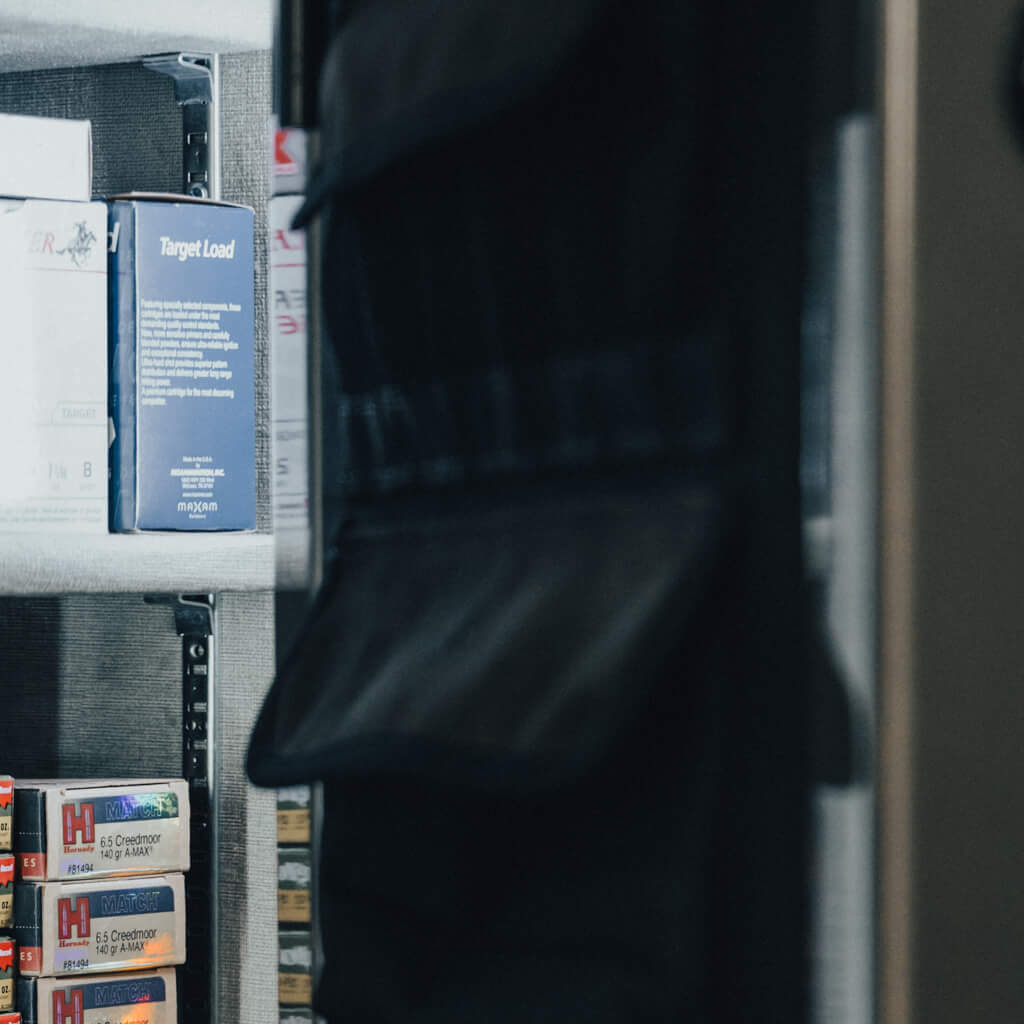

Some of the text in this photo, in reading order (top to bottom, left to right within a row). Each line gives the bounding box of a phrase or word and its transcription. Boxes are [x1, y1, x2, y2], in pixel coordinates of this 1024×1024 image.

[159, 236, 236, 262] Target Load
[104, 799, 163, 820] MATCH
[100, 832, 161, 848] 6.5 Creedmoor
[101, 850, 114, 860] 140
[115, 850, 123, 861] gr
[67, 863, 94, 875] #81494
[100, 891, 160, 915] MATCH
[95, 928, 157, 944] 6.5 Creedmoor
[95, 944, 109, 955] 140
[110, 945, 118, 956] gr
